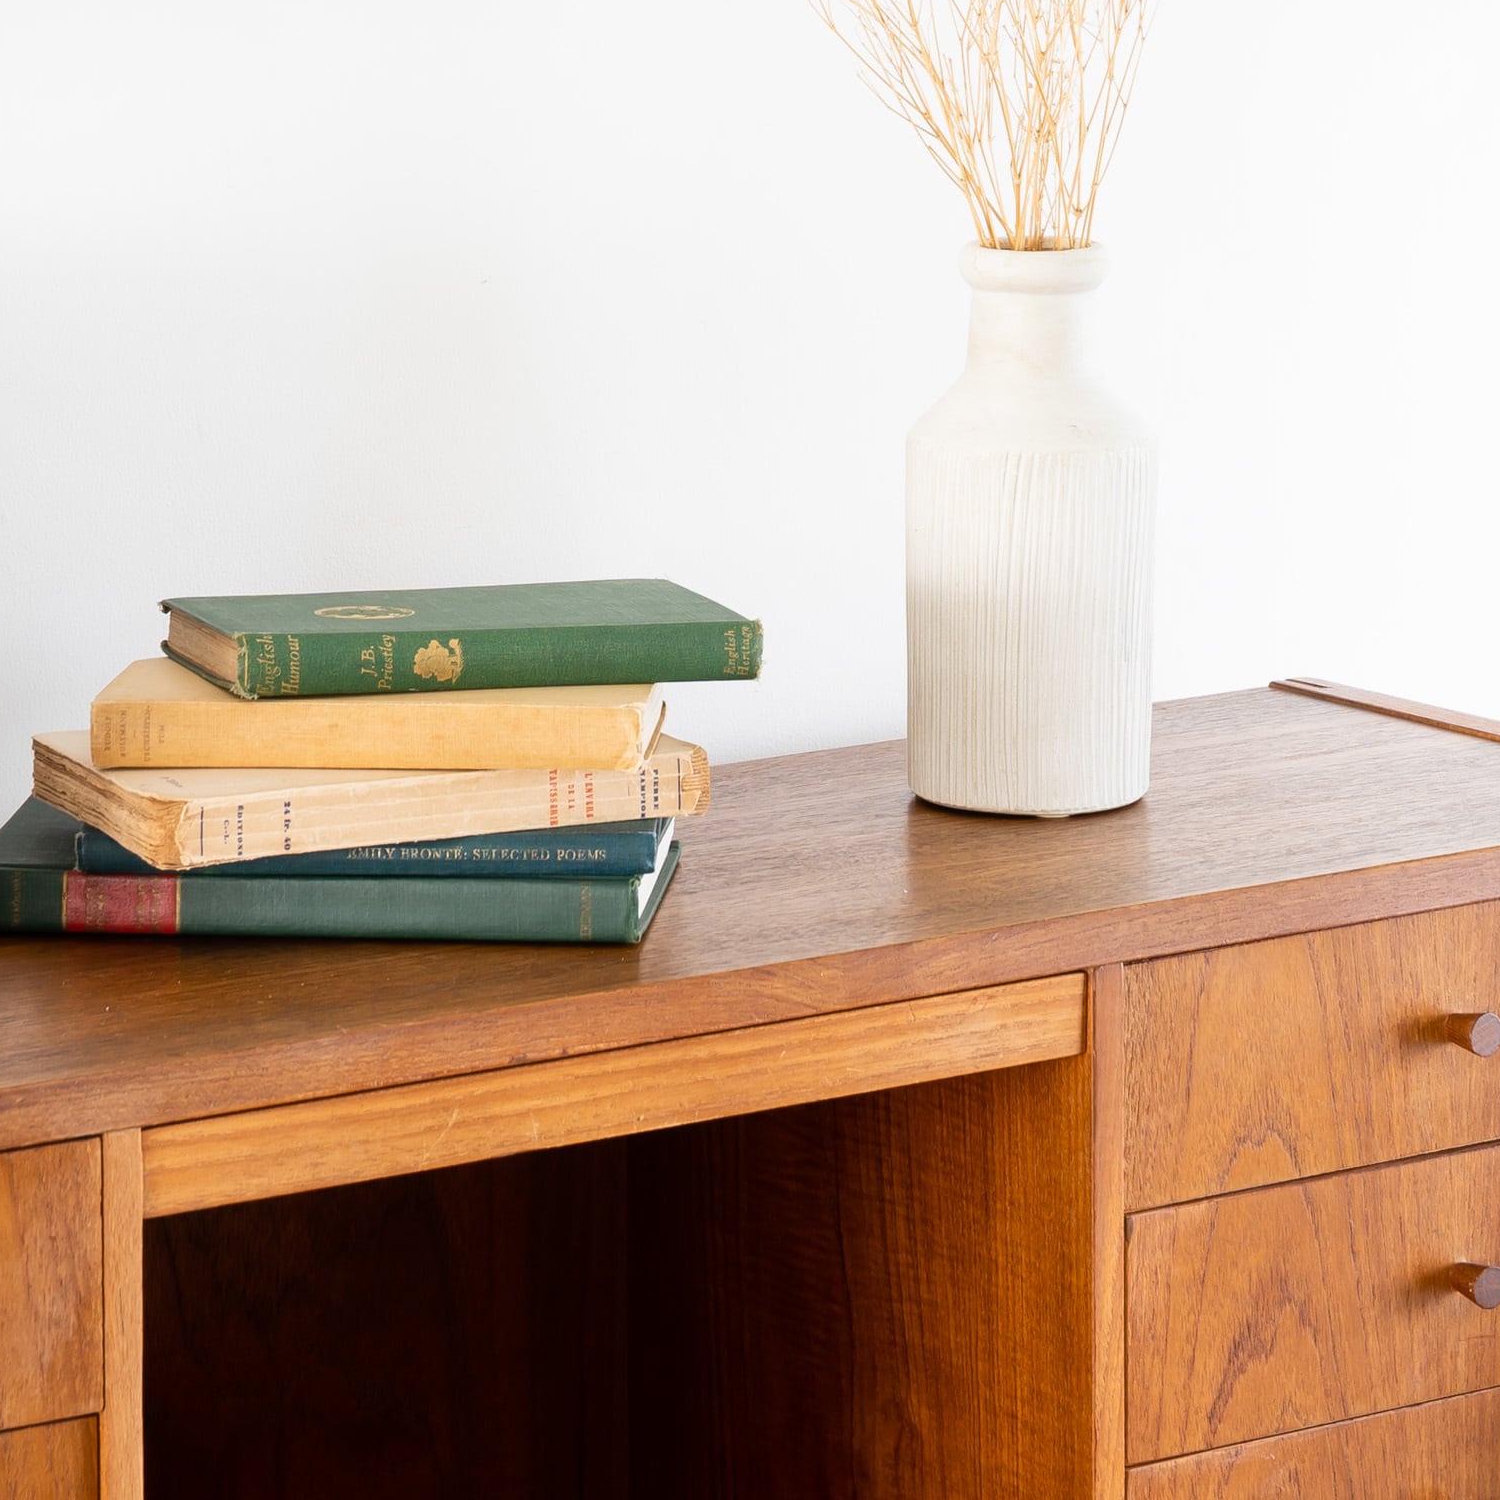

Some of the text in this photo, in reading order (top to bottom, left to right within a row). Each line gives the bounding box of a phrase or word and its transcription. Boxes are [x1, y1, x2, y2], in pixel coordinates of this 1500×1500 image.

[256, 634, 282, 696] English
[281, 634, 300, 695] Humour
[377, 634, 397, 690] Priestley
[723, 629, 740, 674] English
[652, 768, 660, 811] PIERRE
[346, 846, 397, 861] EMILY
[472, 848, 551, 861] SELECTED
[556, 848, 607, 861] POEMS
